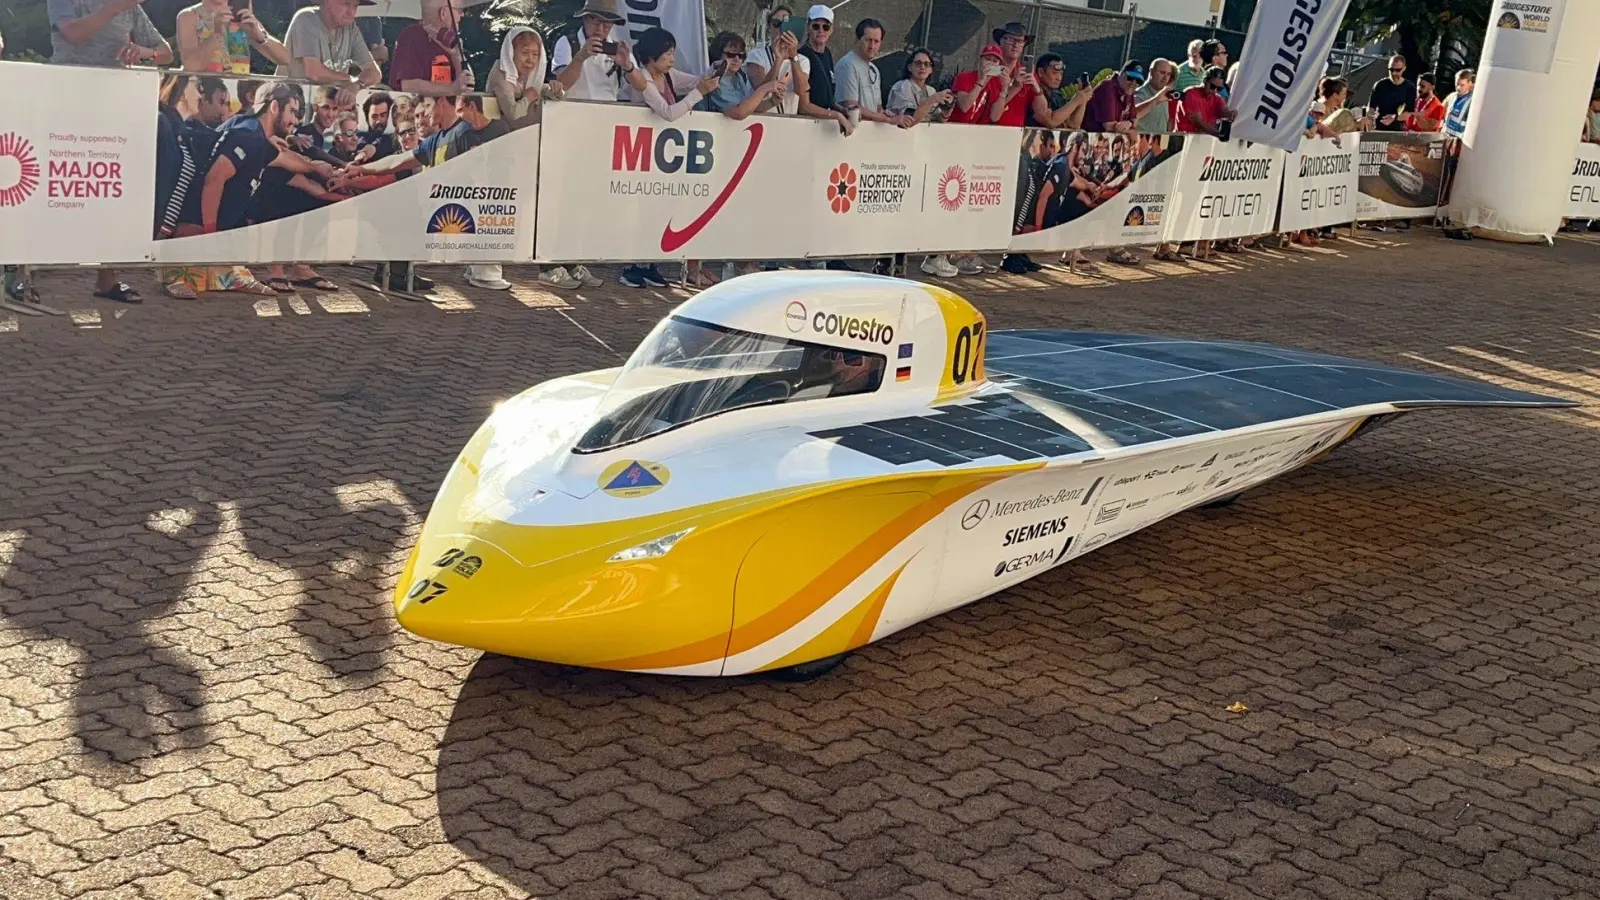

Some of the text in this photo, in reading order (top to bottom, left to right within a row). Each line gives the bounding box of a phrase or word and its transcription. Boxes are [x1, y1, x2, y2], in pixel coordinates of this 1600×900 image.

[1523, 13, 1550, 22] WORLD
[49, 132, 127, 144] Proudly supported by
[49, 149, 121, 160] Northern Territory
[611, 125, 714, 174] MCB
[48, 160, 122, 179] MAJOR
[1199, 156, 1272, 182] BRIDGESTONE
[1299, 153, 1352, 177] BRIDGESTONE
[47, 180, 123, 198] EVENTS
[609, 180, 710, 197] McLAUGHLIN CB
[859, 174, 912, 188] NORTHERN
[969, 181, 1002, 193] MAJOR
[429, 183, 518, 200] BRIDGESTONE
[858, 189, 905, 203] TERRITORY
[968, 194, 1001, 206] EVENTS
[1300, 185, 1348, 211] ENLITEN
[47, 200, 85, 209] Company
[478, 204, 517, 215] WORLD
[857, 203, 902, 214] GOVERNMENT
[1200, 193, 1261, 218] ENLITEN
[476, 216, 515, 227] SOLAR
[476, 227, 515, 235] CHALLENGE
[425, 242, 515, 250] WORLDSOLARCHALLENGE.ORG
[812, 311, 894, 345] covestro
[952, 321, 983, 386] 07
[989, 488, 1084, 519] Mercedes-Benz
[1002, 516, 1069, 547] SIEMENS
[408, 579, 449, 605] 07
